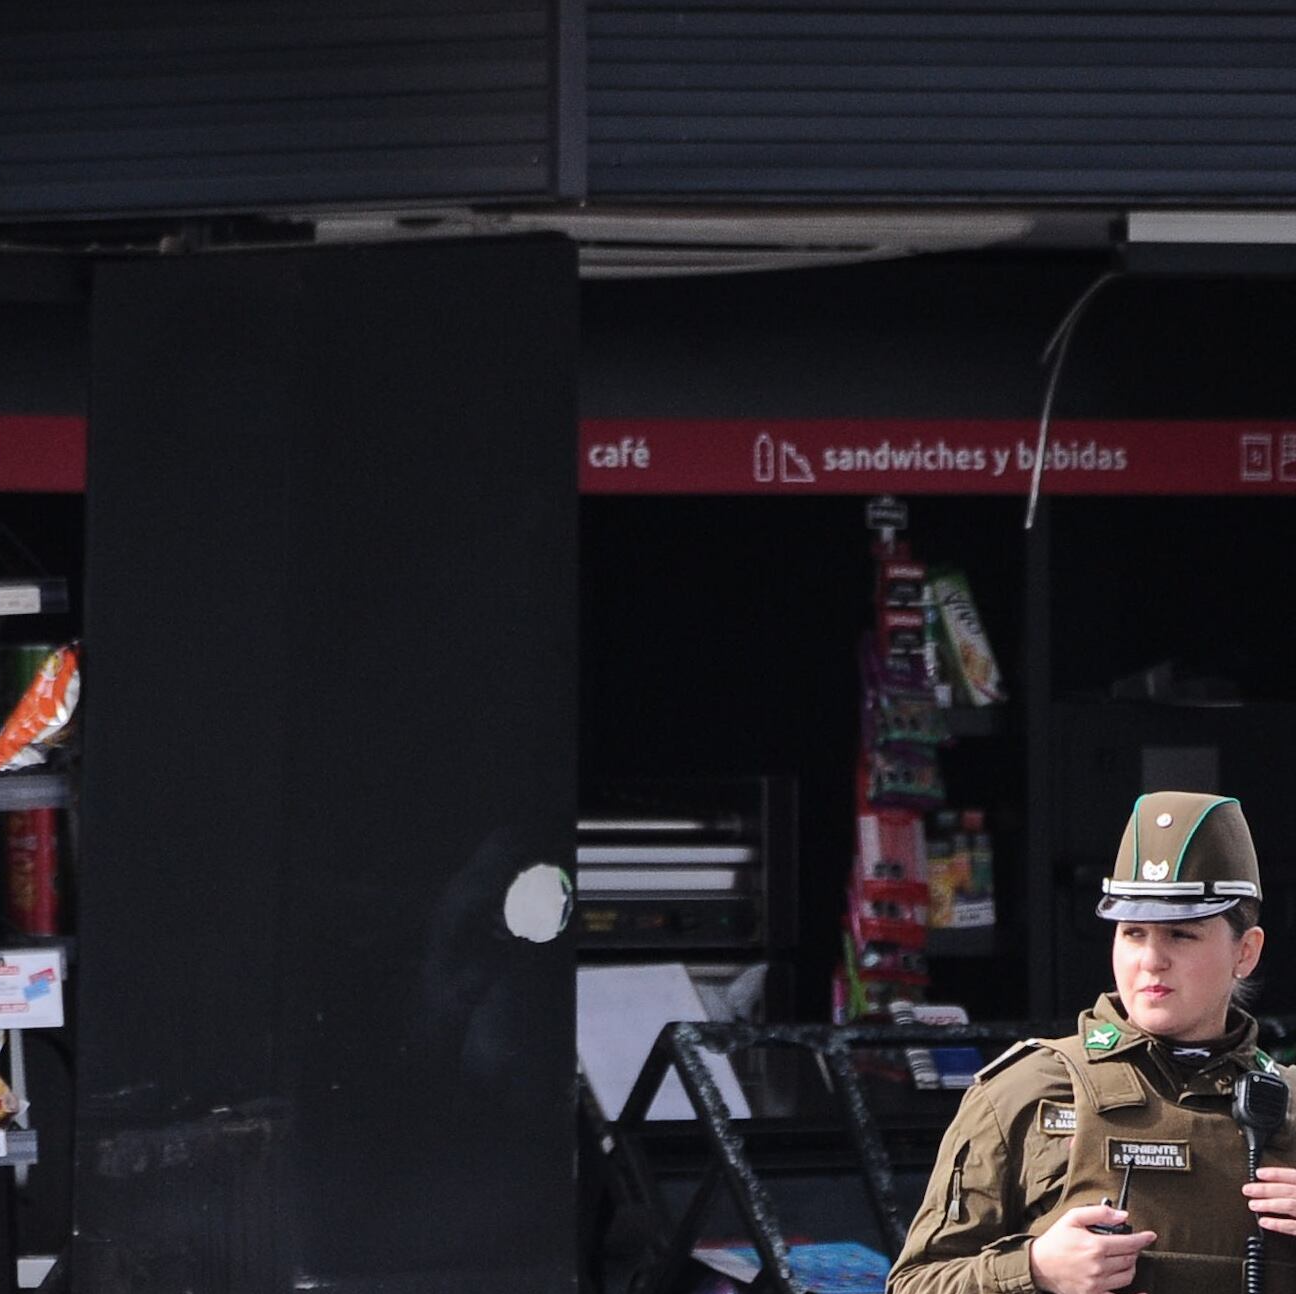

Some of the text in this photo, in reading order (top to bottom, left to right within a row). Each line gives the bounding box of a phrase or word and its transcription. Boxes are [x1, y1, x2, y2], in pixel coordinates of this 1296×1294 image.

[588, 436, 650, 469] café
[823, 441, 1127, 476] sandwiches y bebidas
[1120, 1144, 1179, 1156] TENIENTE
